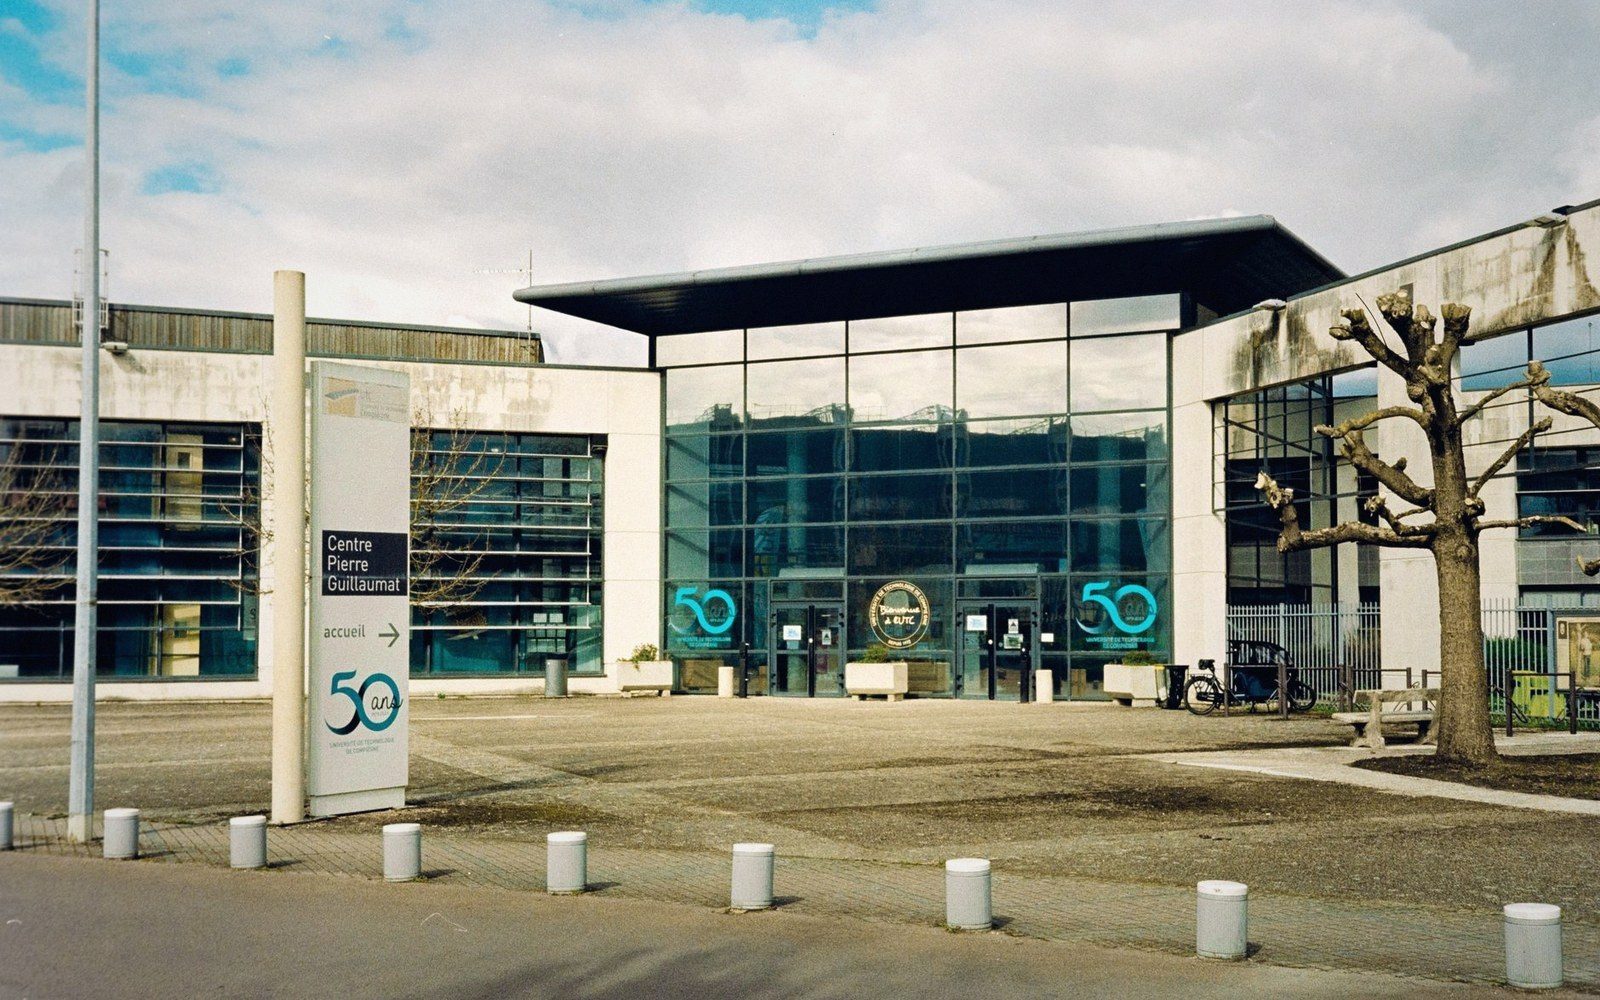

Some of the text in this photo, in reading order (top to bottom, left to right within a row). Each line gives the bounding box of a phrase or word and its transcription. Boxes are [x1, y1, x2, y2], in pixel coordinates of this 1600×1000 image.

[327, 535, 372, 551] Centre
[327, 555, 369, 571] Pierre
[327, 575, 400, 591] Guillaumat
[668, 586, 735, 634] 50
[1076, 581, 1157, 633] 50
[323, 624, 366, 638] accueil
[324, 670, 400, 736] 50
[371, 696, 404, 711] ans
